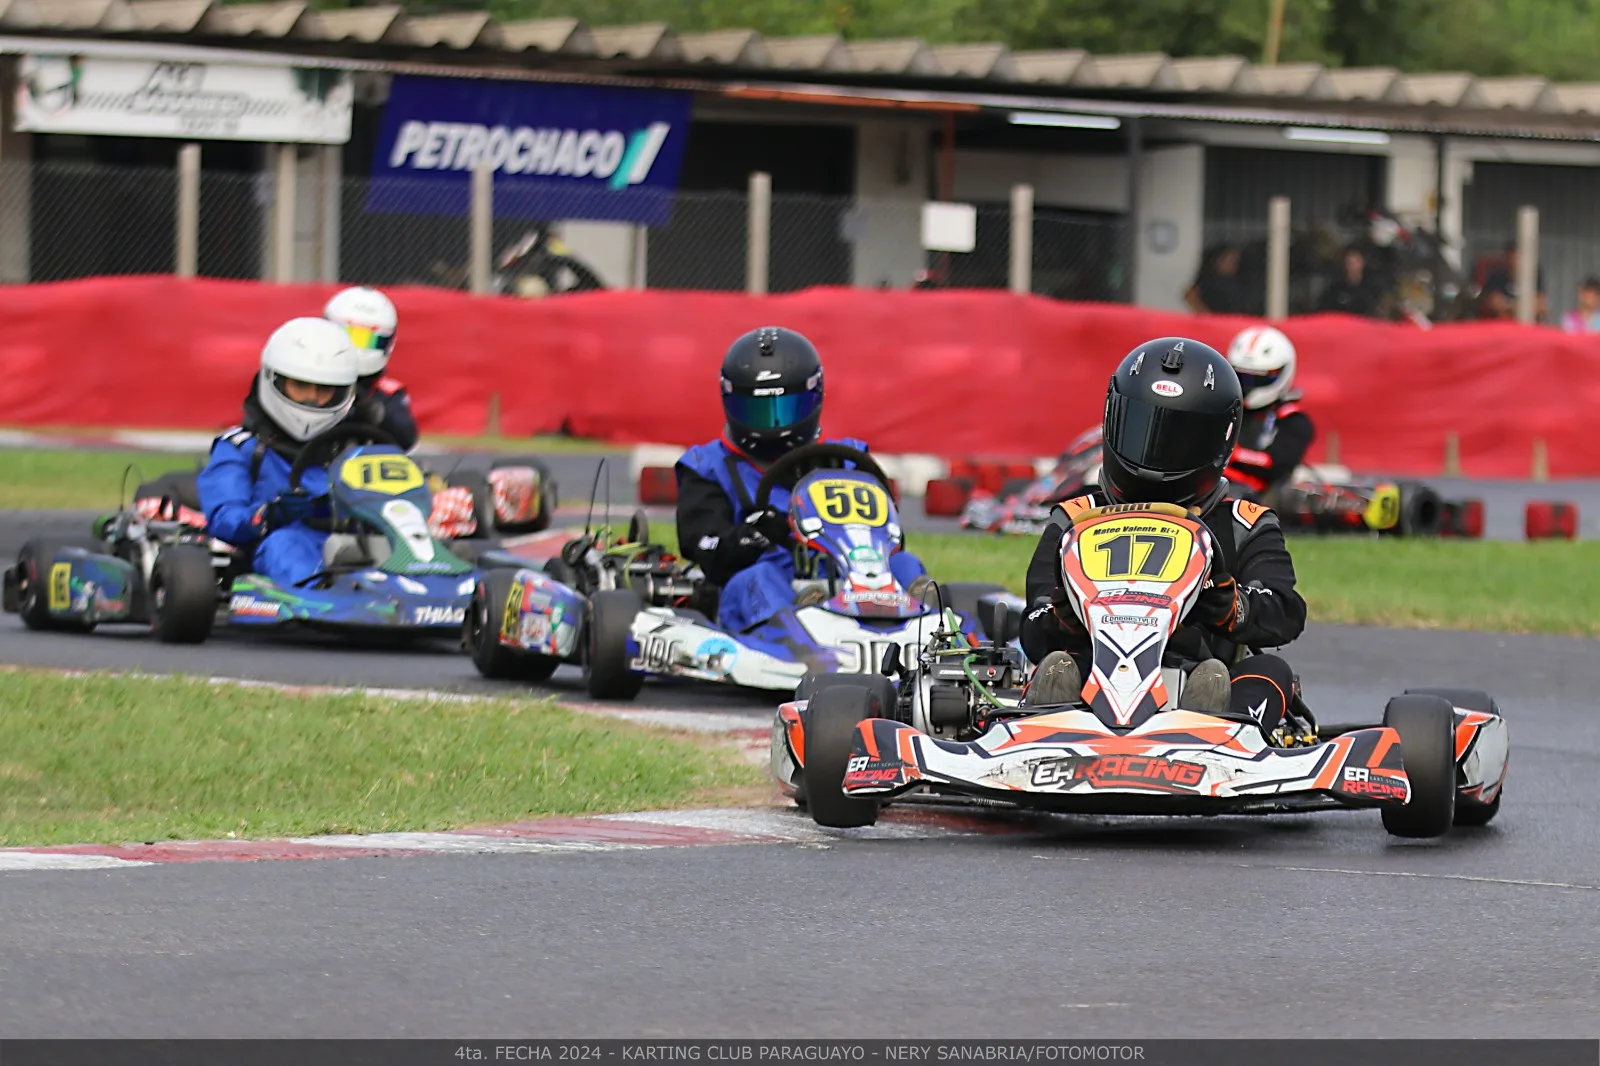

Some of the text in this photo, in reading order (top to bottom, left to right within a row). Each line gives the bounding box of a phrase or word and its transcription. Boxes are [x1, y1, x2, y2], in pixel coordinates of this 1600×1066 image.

[389, 120, 625, 179] PETROCHACO
[1156, 383, 1178, 393] BELL
[824, 485, 878, 521] 59
[1093, 527, 1121, 536] Mateo
[1122, 525, 1157, 533] Valente
[1095, 533, 1176, 578] 17
[1073, 757, 1204, 784] RACING
[1342, 780, 1407, 799] RACING
